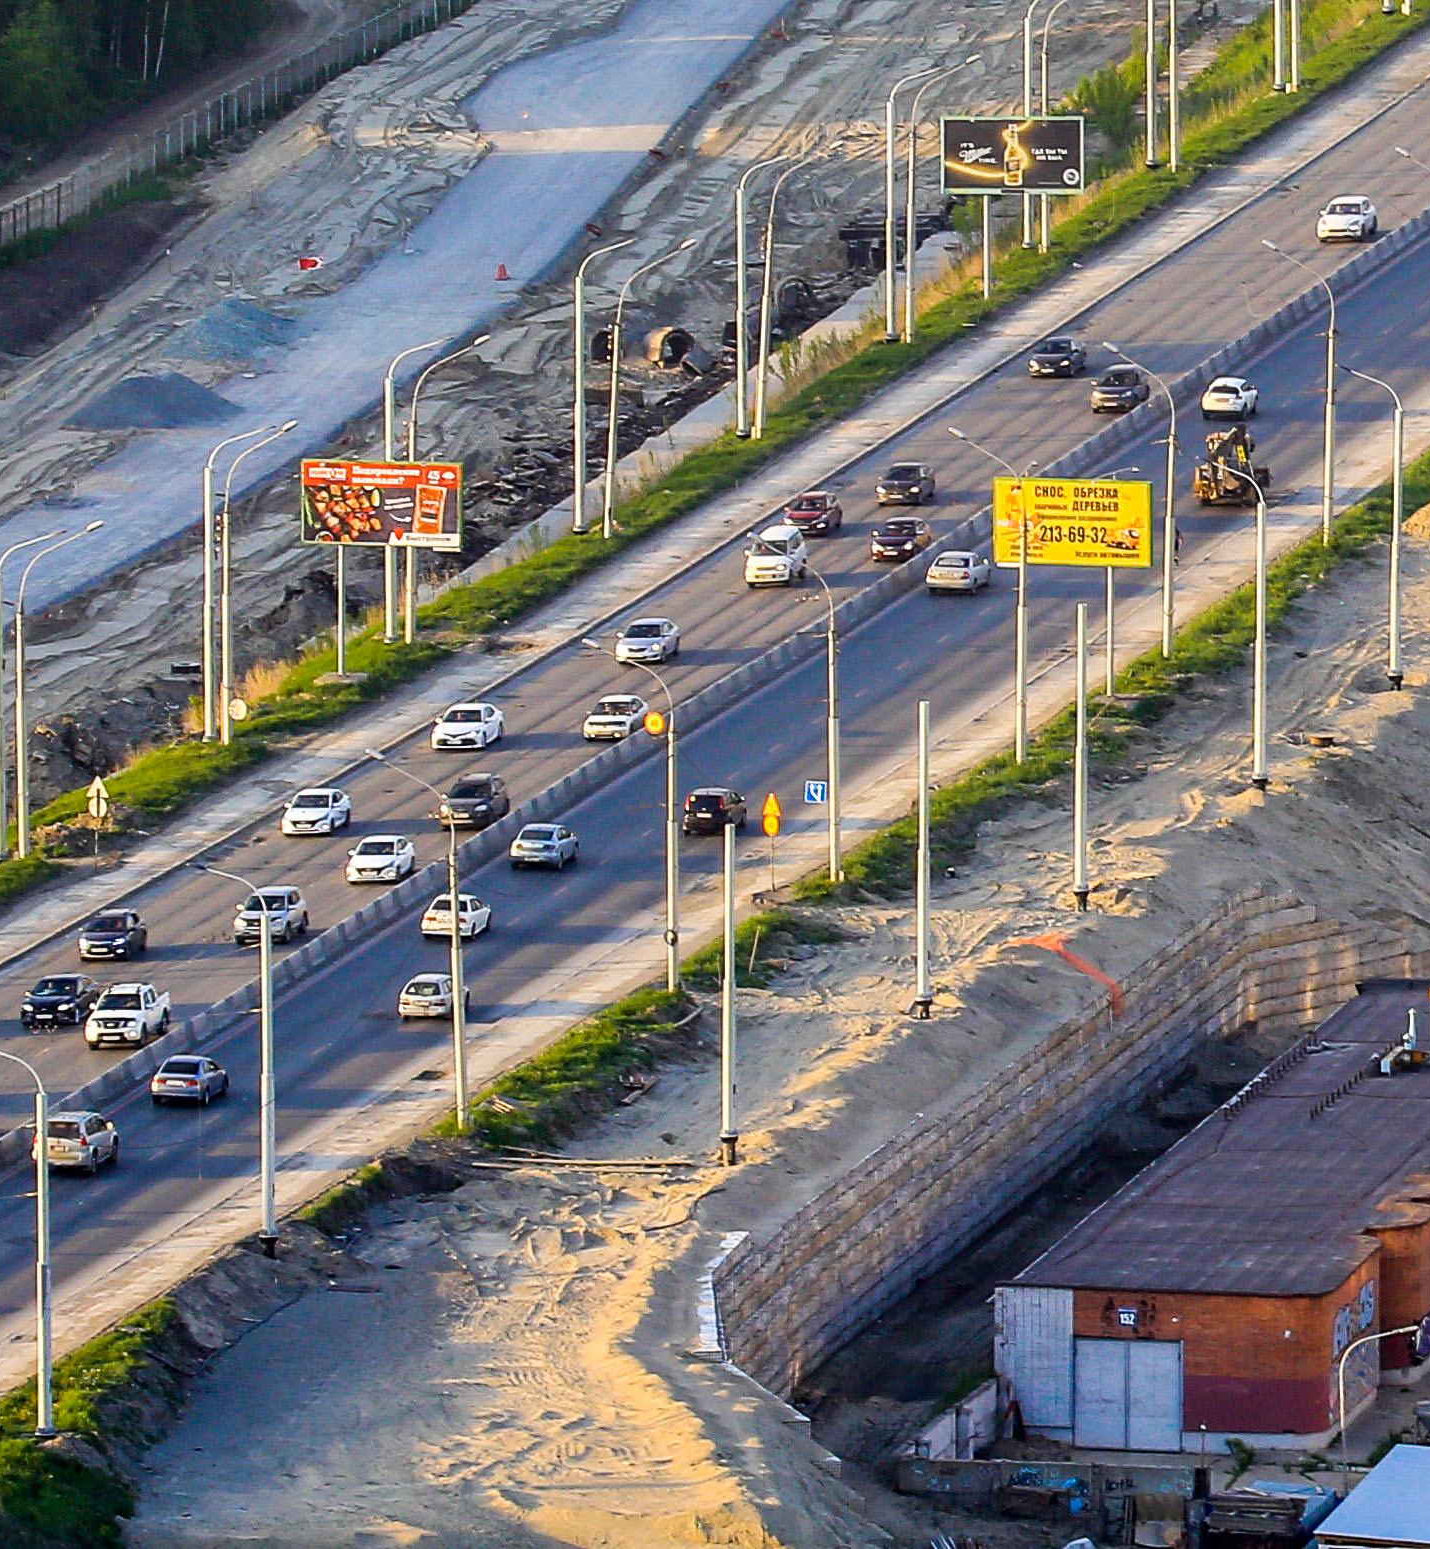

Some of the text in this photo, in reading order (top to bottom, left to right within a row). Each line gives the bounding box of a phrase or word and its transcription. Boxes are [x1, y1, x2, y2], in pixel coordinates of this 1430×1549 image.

[1073, 487, 1119, 499] ОБРЕЗКА
[1072, 501, 1119, 512] ДЕРЕВЬЕВ
[1040, 525, 1108, 543] 213-69-32
[1119, 1313, 1135, 1325] 152
